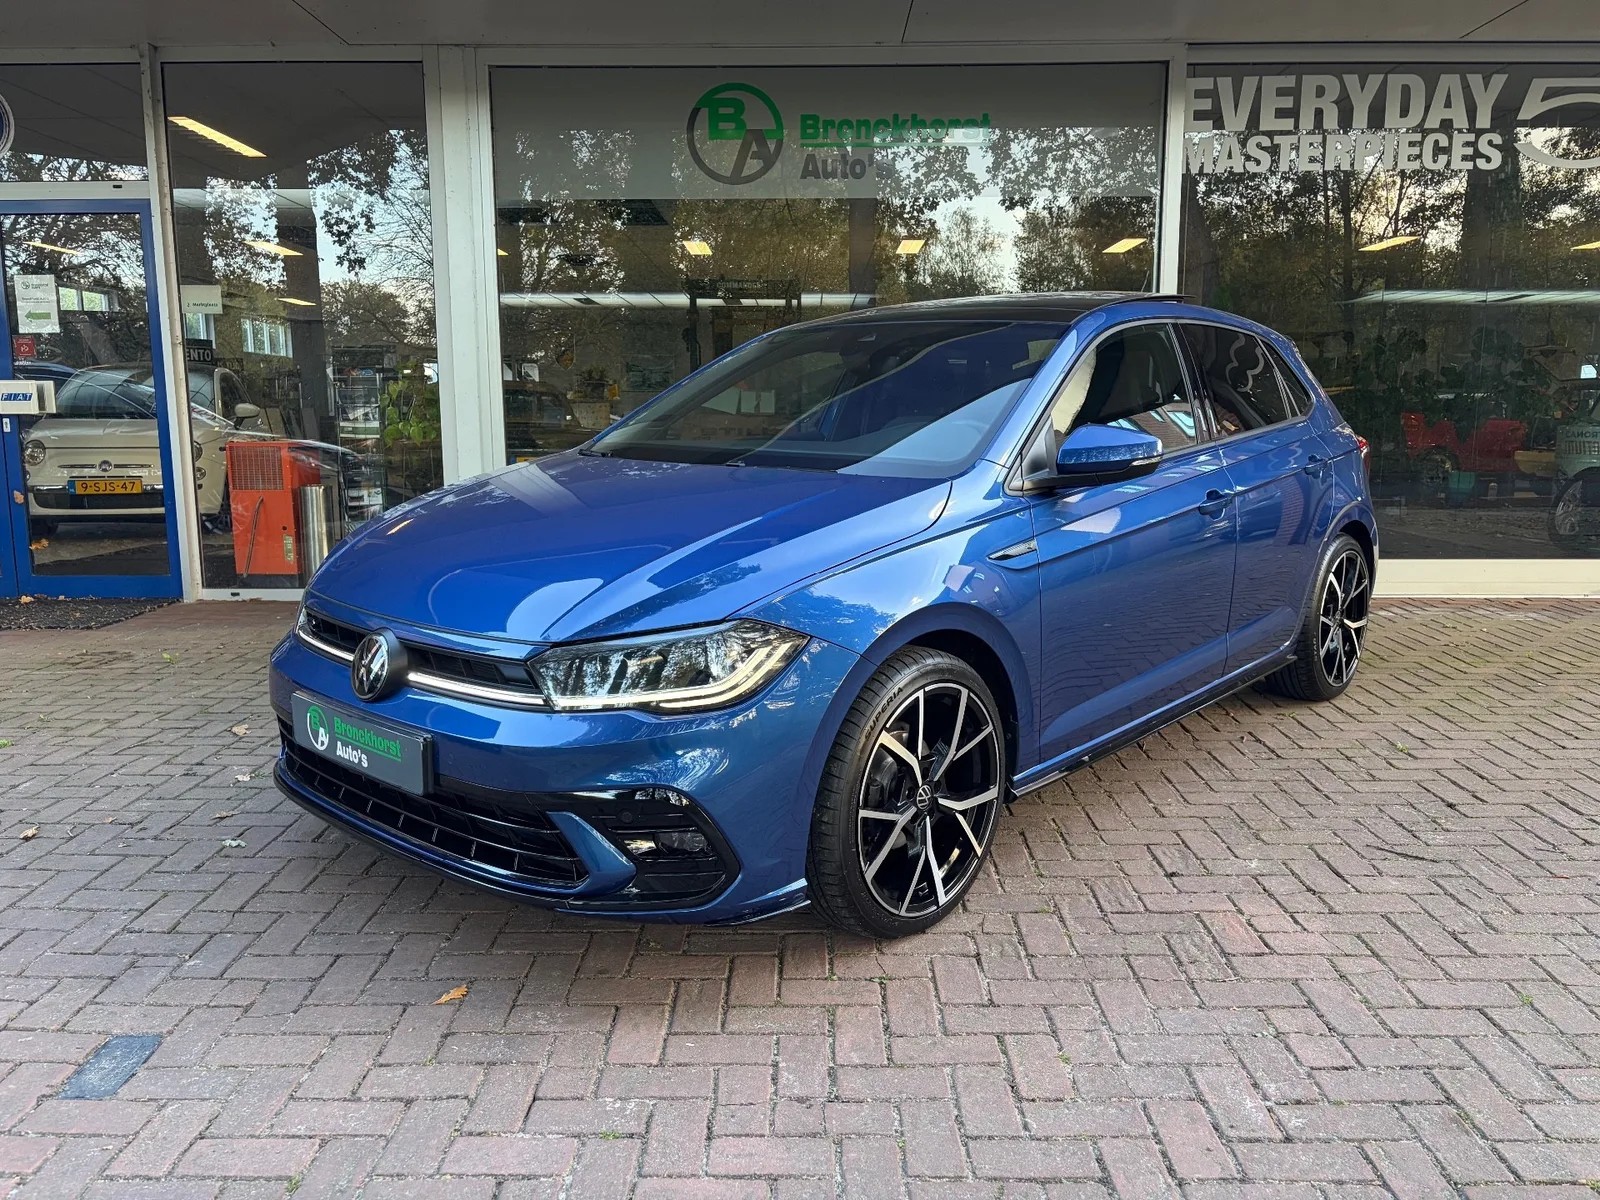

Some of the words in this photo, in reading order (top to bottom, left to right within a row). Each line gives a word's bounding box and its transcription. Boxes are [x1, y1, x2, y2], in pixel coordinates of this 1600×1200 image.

[1184, 73, 1508, 131] EVERYDAY
[800, 113, 991, 139] Bronckhorst
[800, 154, 895, 179] Auto's
[1181, 133, 1503, 173] MASTERPIECES
[2, 393, 32, 401] FIAT
[80, 481, 136, 493] 9-SJS-47
[864, 686, 904, 741] SUPERIA
[334, 716, 401, 756] Bronckhorst
[336, 741, 369, 768] Auto's
